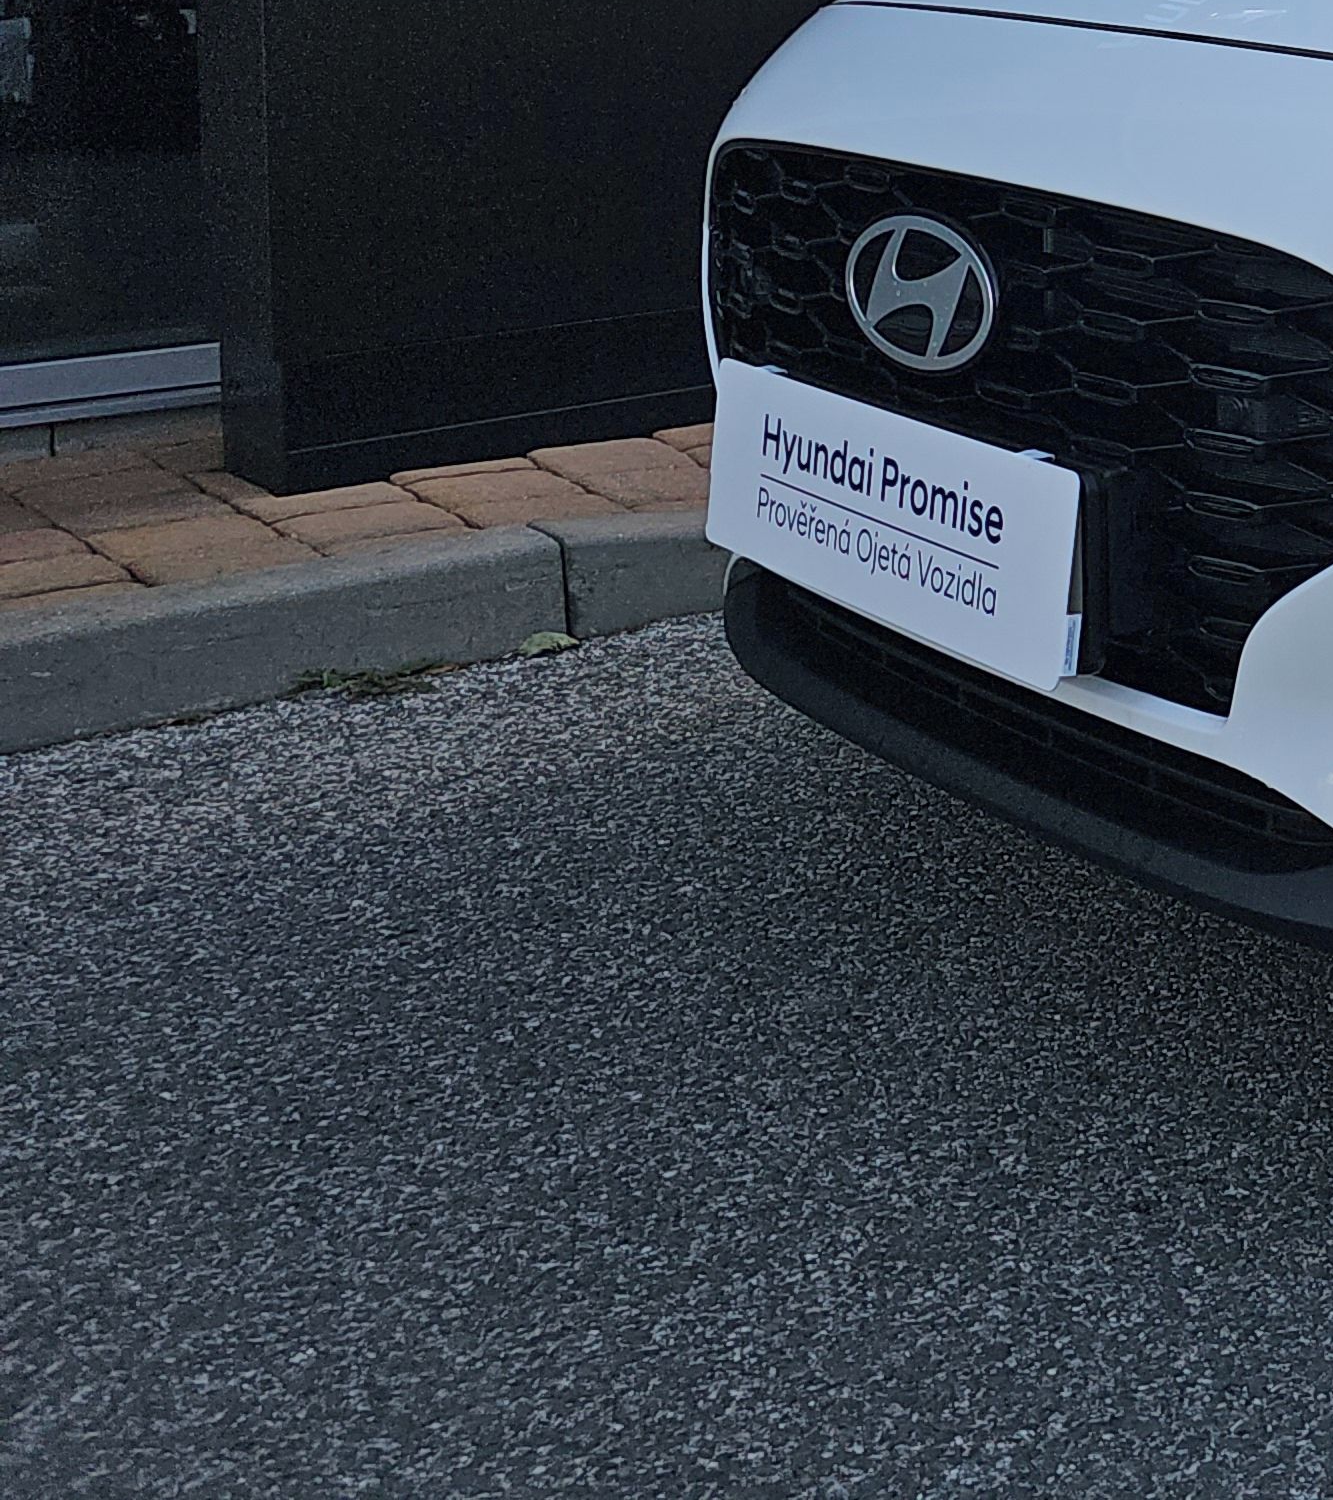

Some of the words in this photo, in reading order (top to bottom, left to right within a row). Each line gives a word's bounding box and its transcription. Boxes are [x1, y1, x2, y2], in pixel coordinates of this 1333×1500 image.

[762, 413, 874, 497] Hyundai
[880, 456, 1004, 545] Promise
[756, 486, 851, 556] Prověřená
[856, 528, 911, 581] Ojetá
[917, 550, 997, 617] Vozidla
